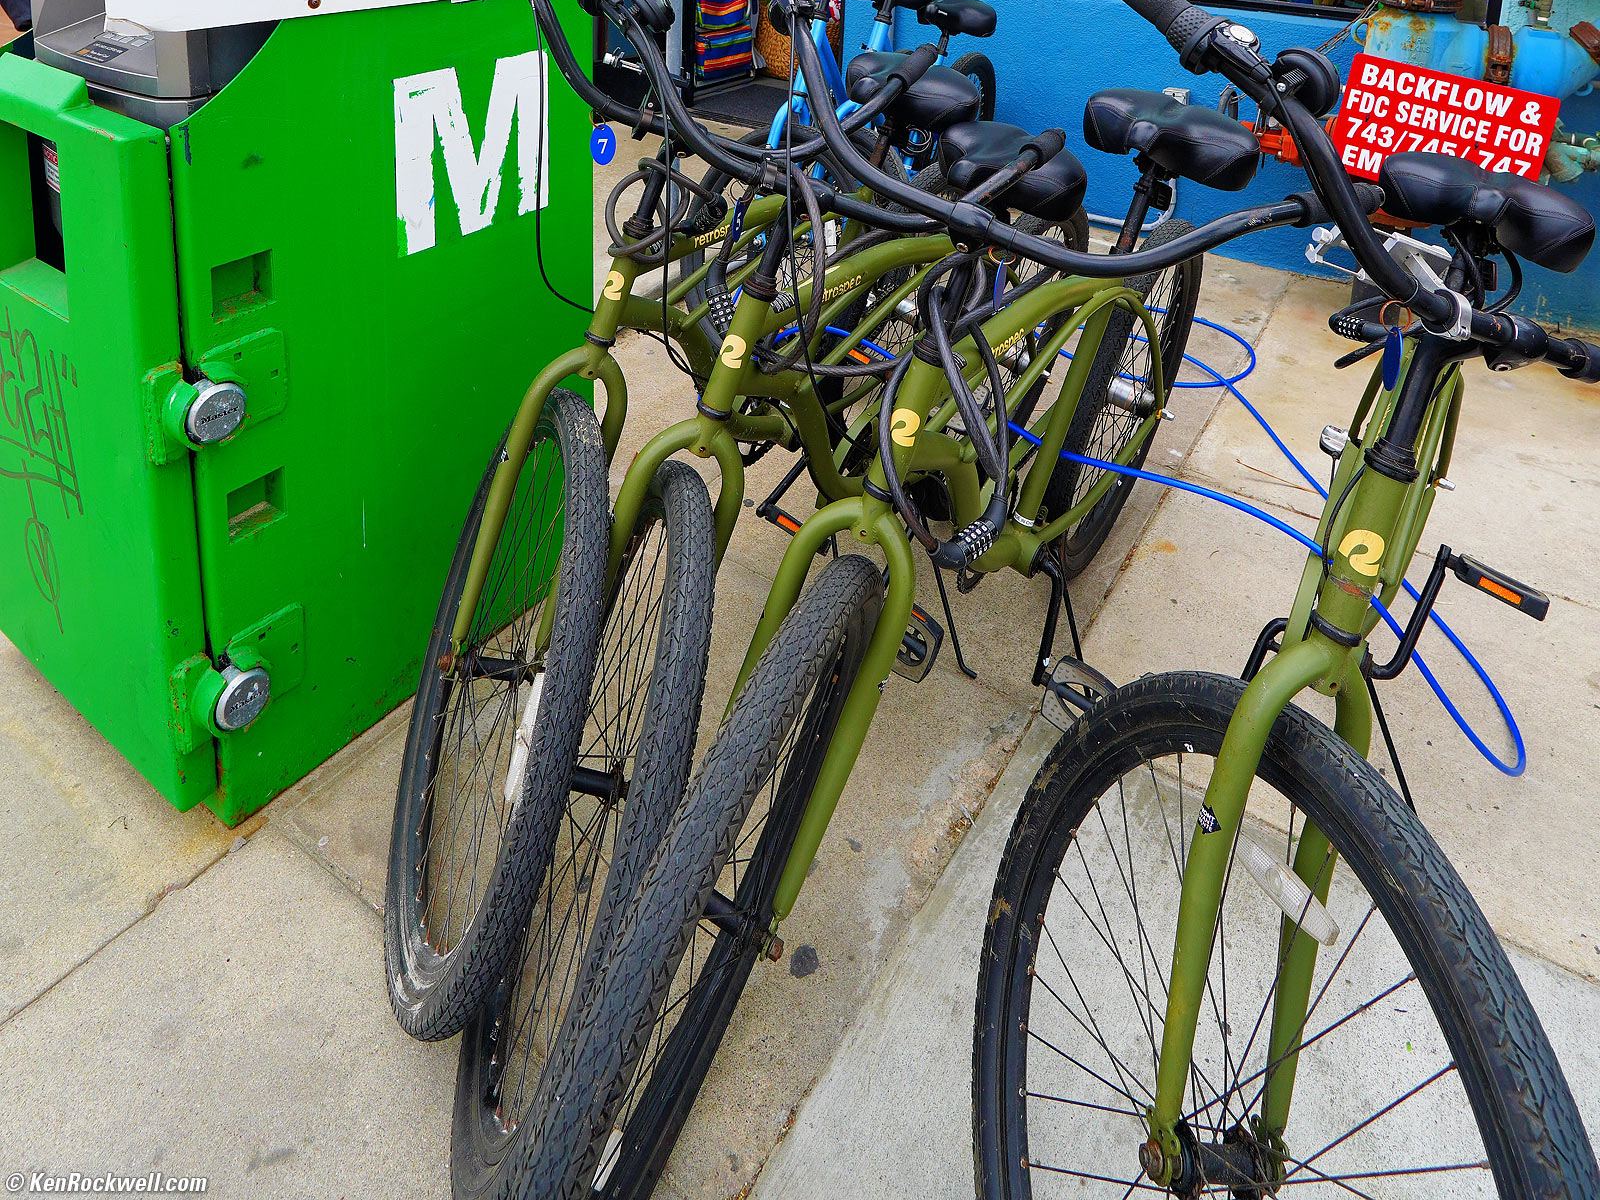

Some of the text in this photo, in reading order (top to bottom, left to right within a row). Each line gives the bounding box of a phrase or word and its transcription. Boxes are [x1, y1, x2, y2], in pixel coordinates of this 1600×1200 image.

[1346, 88, 1543, 157] FDC SERVICE FOR
[1360, 63, 1542, 127] BACKFLOW &
[393, 49, 550, 258] M
[597, 138, 609, 154] 7
[694, 223, 731, 249] retros
